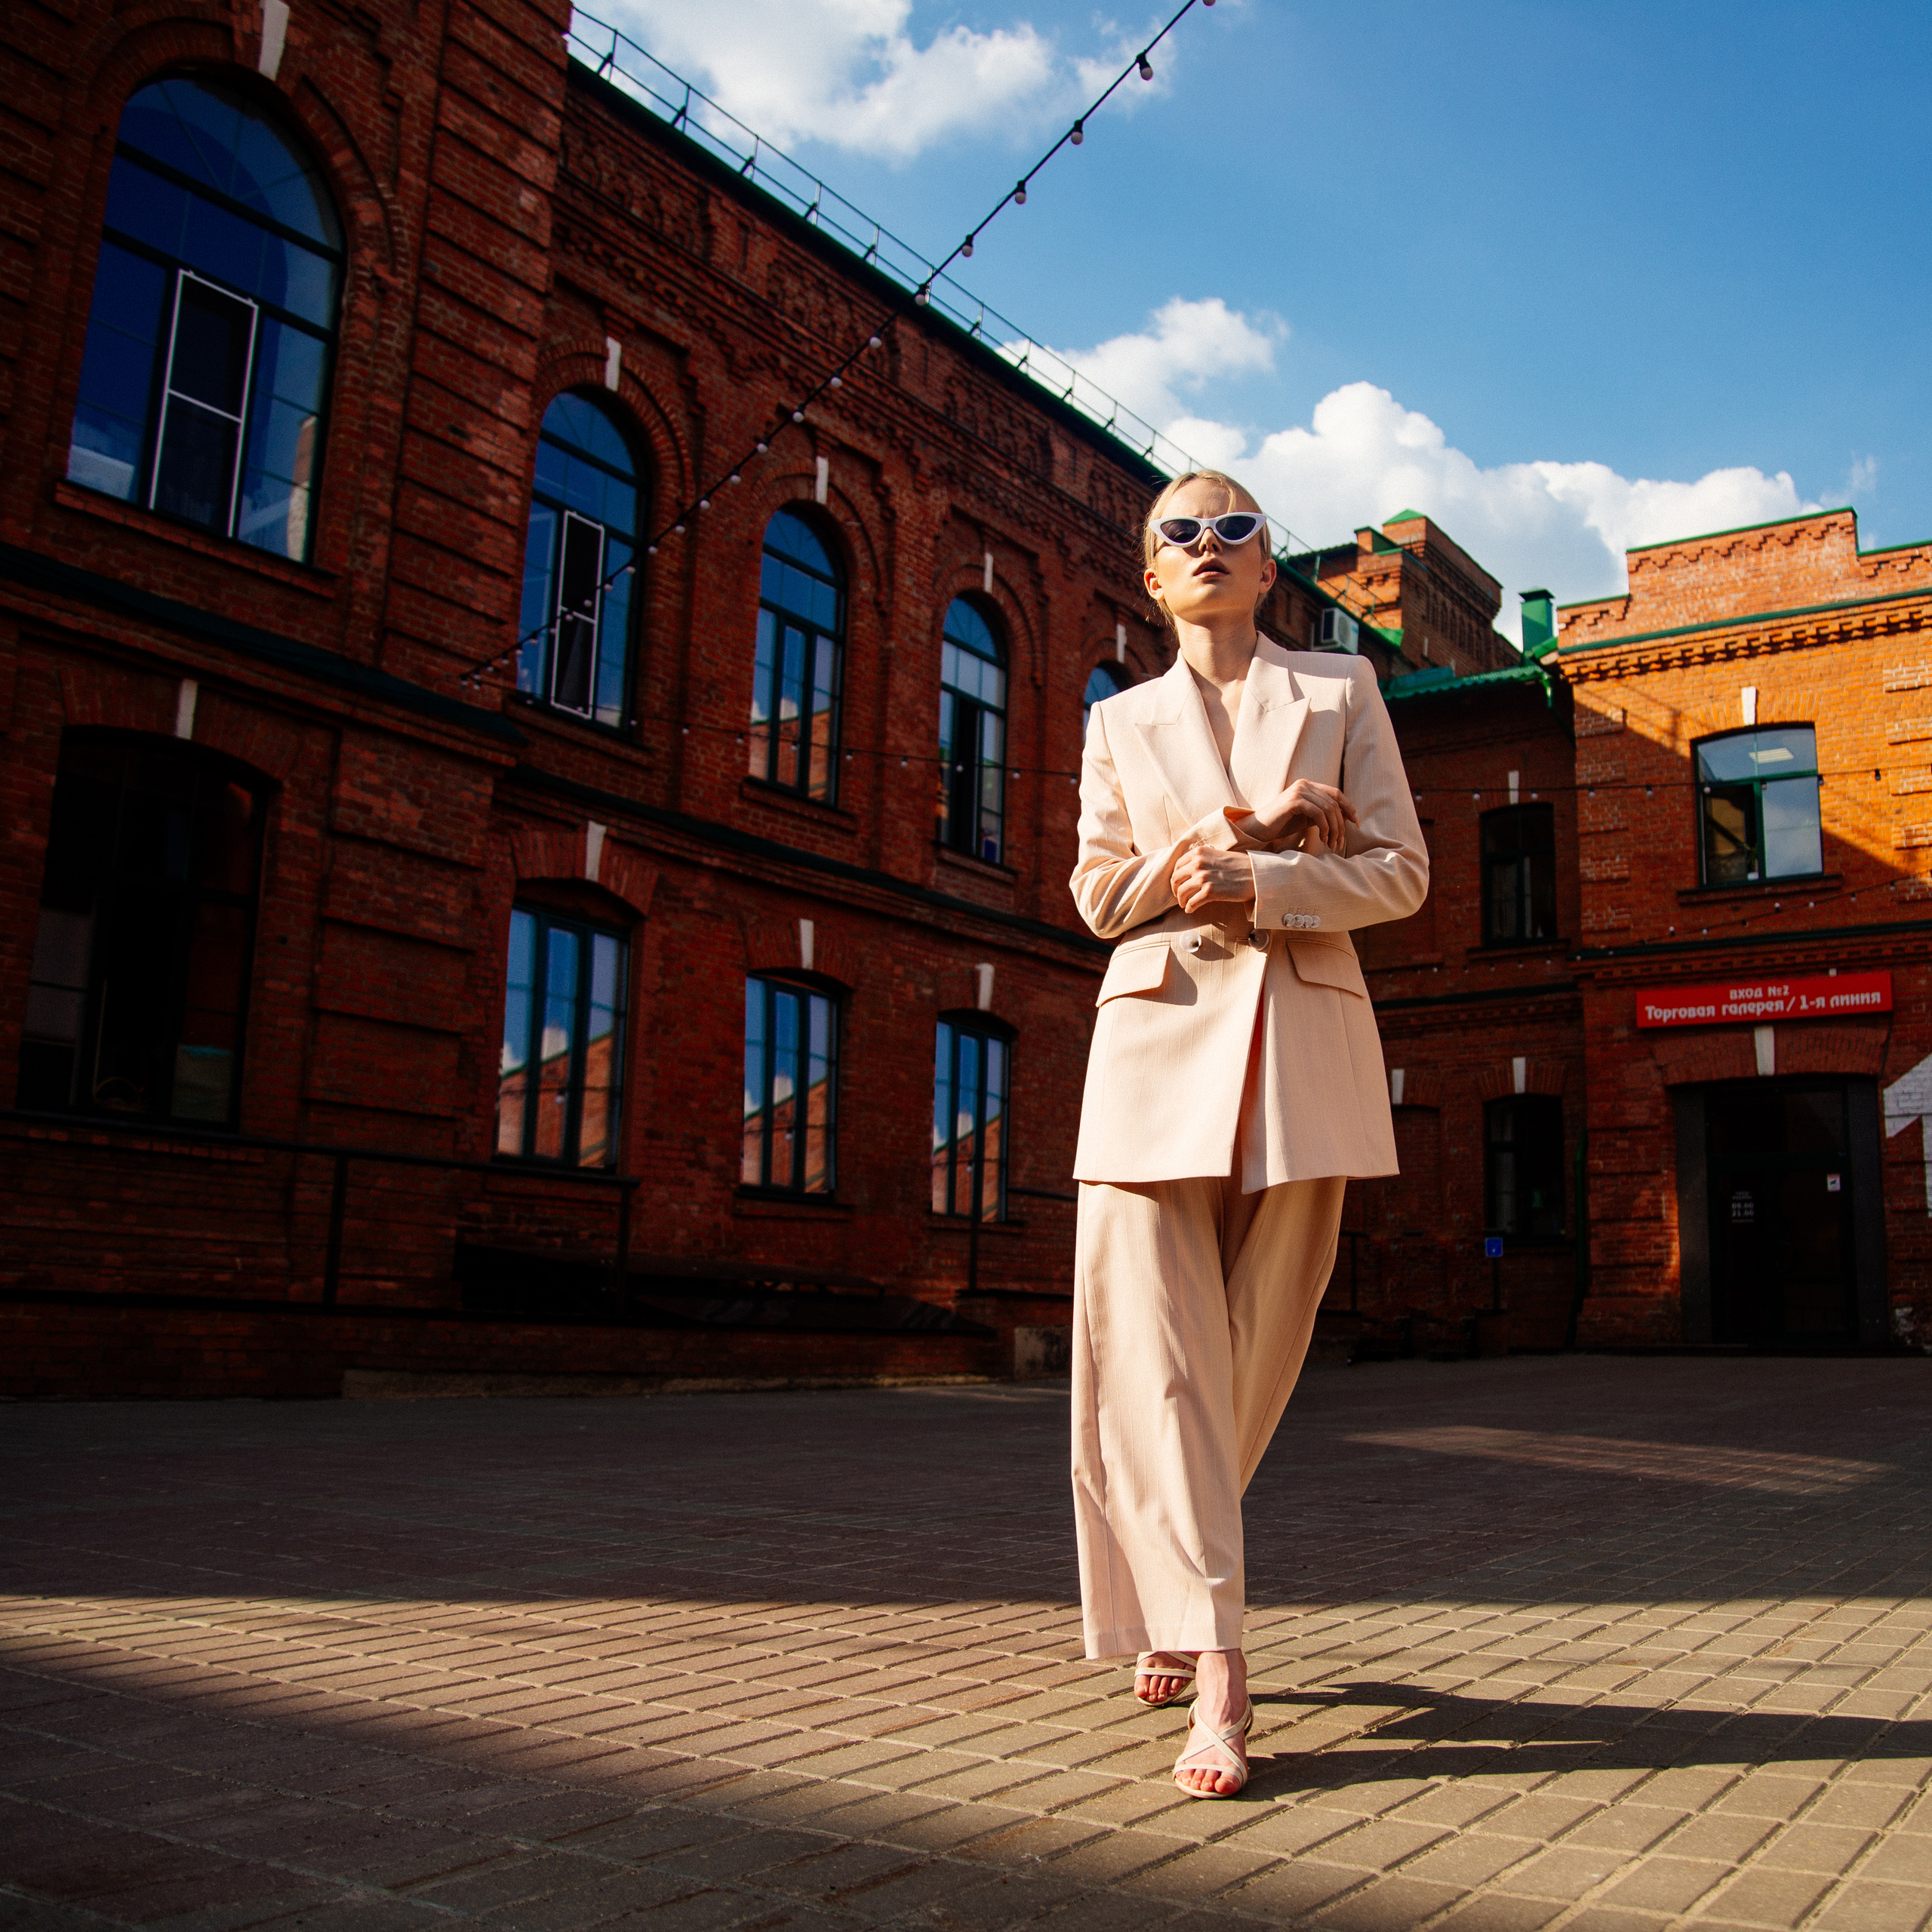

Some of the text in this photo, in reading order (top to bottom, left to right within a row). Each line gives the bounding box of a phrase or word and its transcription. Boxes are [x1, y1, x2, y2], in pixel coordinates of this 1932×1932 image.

[1767, 985, 1789, 997] №2
[1645, 1005, 1715, 1023] Торговая
[1830, 992, 1881, 1008] линия
